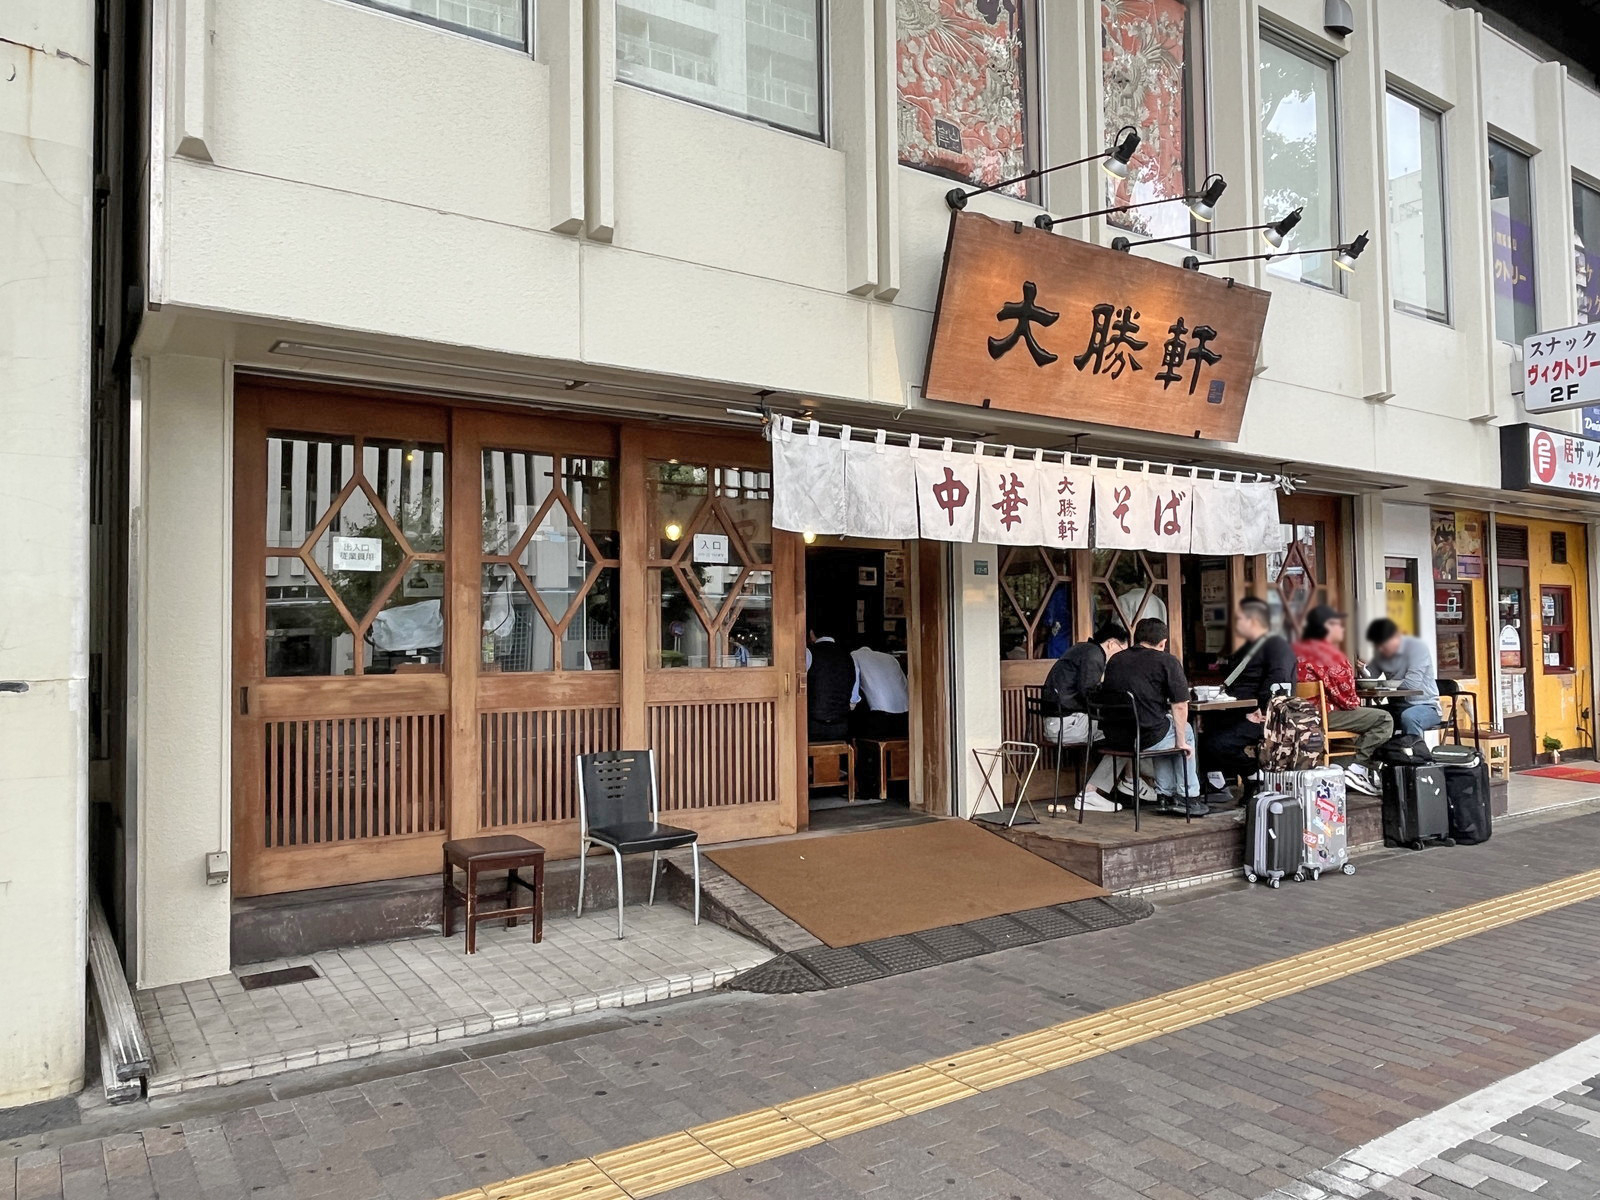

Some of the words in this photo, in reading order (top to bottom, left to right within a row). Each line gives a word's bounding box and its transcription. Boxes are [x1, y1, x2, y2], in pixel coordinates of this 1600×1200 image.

[988, 281, 1222, 396] 大勝軒
[1529, 330, 1597, 359] スナック
[1527, 355, 1600, 386] ヴィクトリー
[1550, 383, 1579, 403] 2F
[1537, 438, 1552, 474] 2F
[1568, 471, 1600, 490] カラオケ
[1057, 476, 1079, 542] 大勝軒
[343, 543, 370, 552] 出入口
[701, 540, 721, 550] 入口
